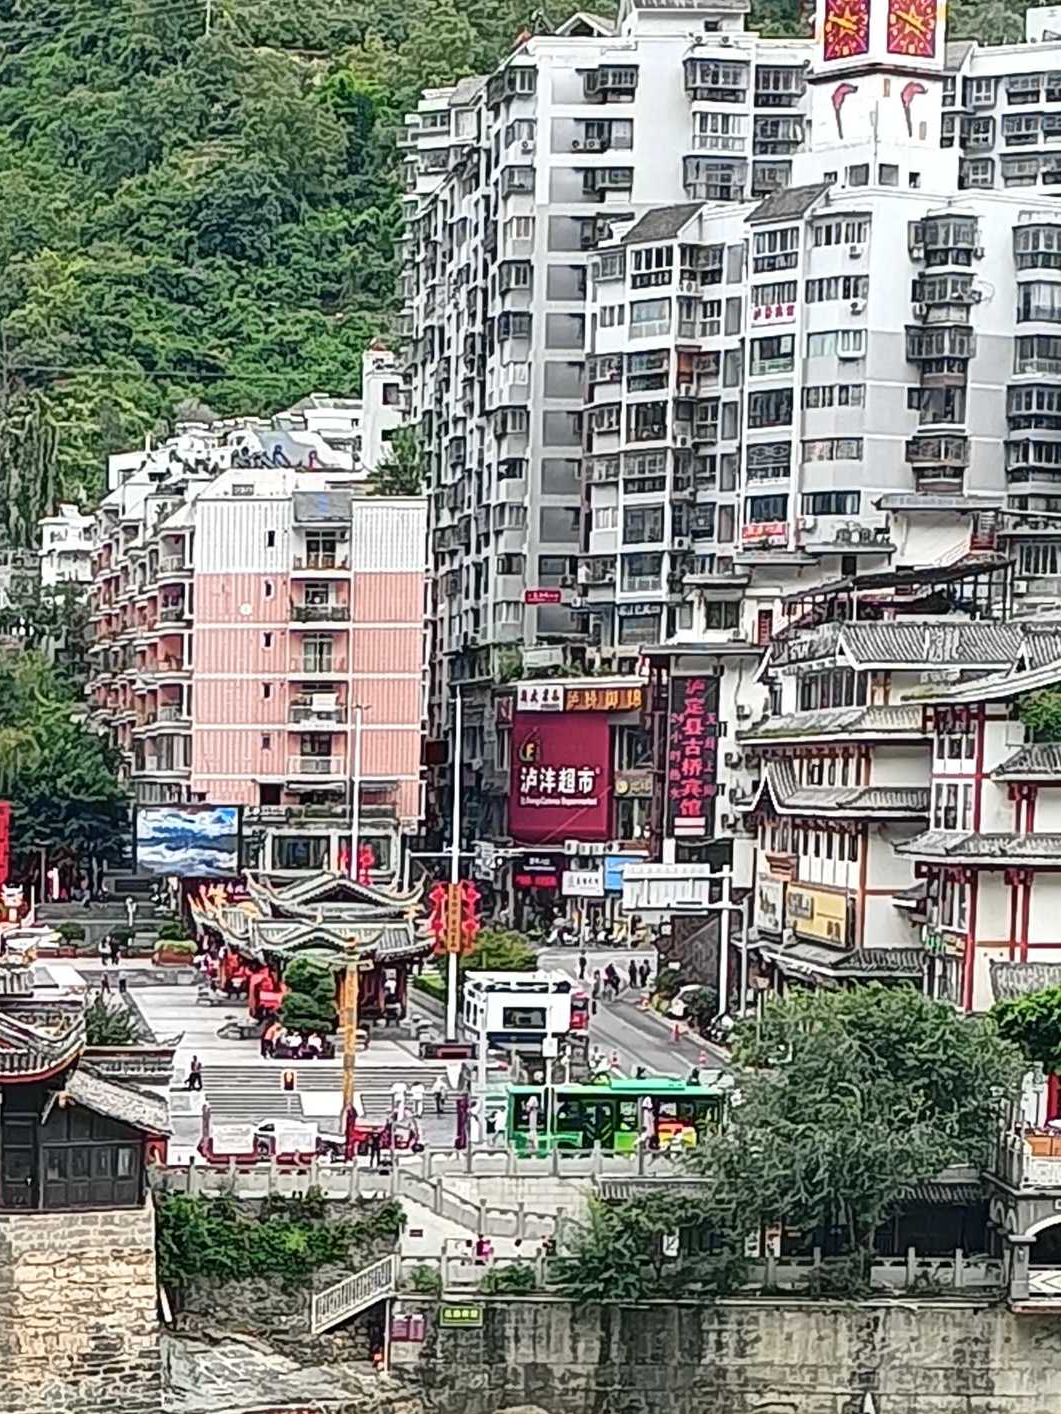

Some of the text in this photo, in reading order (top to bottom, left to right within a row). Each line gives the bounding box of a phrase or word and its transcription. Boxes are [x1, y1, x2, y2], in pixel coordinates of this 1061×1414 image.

[679, 679, 707, 816] 泸定县古桥宾馆
